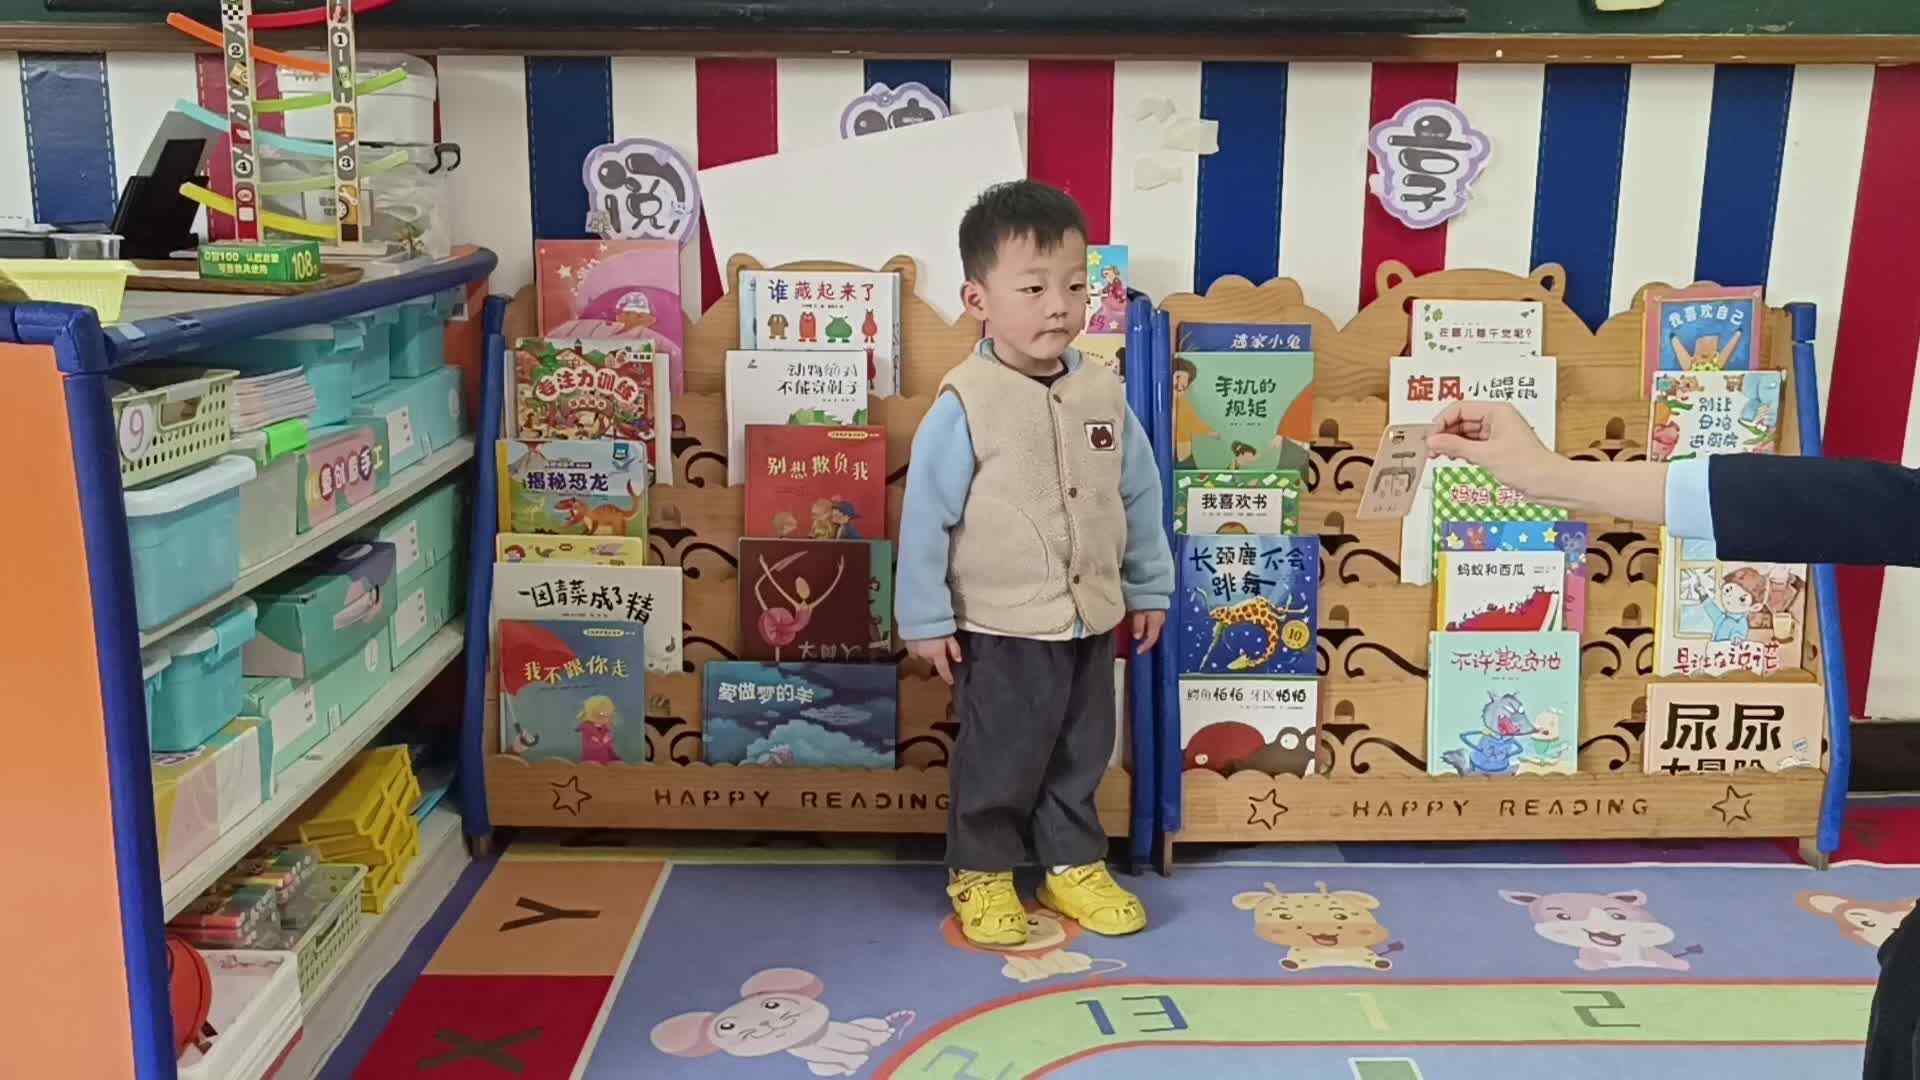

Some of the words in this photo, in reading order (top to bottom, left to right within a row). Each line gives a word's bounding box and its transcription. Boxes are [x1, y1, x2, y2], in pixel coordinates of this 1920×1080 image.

[1388, 115, 1472, 213] 享
[768, 279, 874, 303] 谁藏起来了
[1668, 304, 1745, 328] 我喜欢自己
[1215, 376, 1277, 397] 手机的
[1225, 398, 1267, 418] 规矩
[129, 409, 144, 452] 9
[767, 452, 868, 480] 别想欺负我
[527, 471, 608, 491] 揭秘恐龙
[1202, 493, 1268, 509] 我喜欢书
[1189, 542, 1305, 574] 长颈鹿不会
[1457, 563, 1526, 577] 蚂蚁和西瓜
[1212, 571, 1276, 601] 跳舞
[518, 579, 654, 624] 一园青菜成了精
[1289, 628, 1302, 641] 10
[523, 655, 630, 685] 我不跟你走
[1451, 646, 1561, 674] 不许欺负他
[1660, 702, 1785, 751] 尿尿
[654, 788, 771, 808] HAPPY
[800, 790, 950, 811] READING
[1352, 799, 1471, 818] HAPPY
[1500, 798, 1650, 817] READING
[499, 897, 600, 931] Y
[1076, 994, 1189, 1035] 13
[1344, 992, 1389, 1031] 1
[1560, 990, 1641, 1028] 2
[416, 1026, 544, 1071] X
